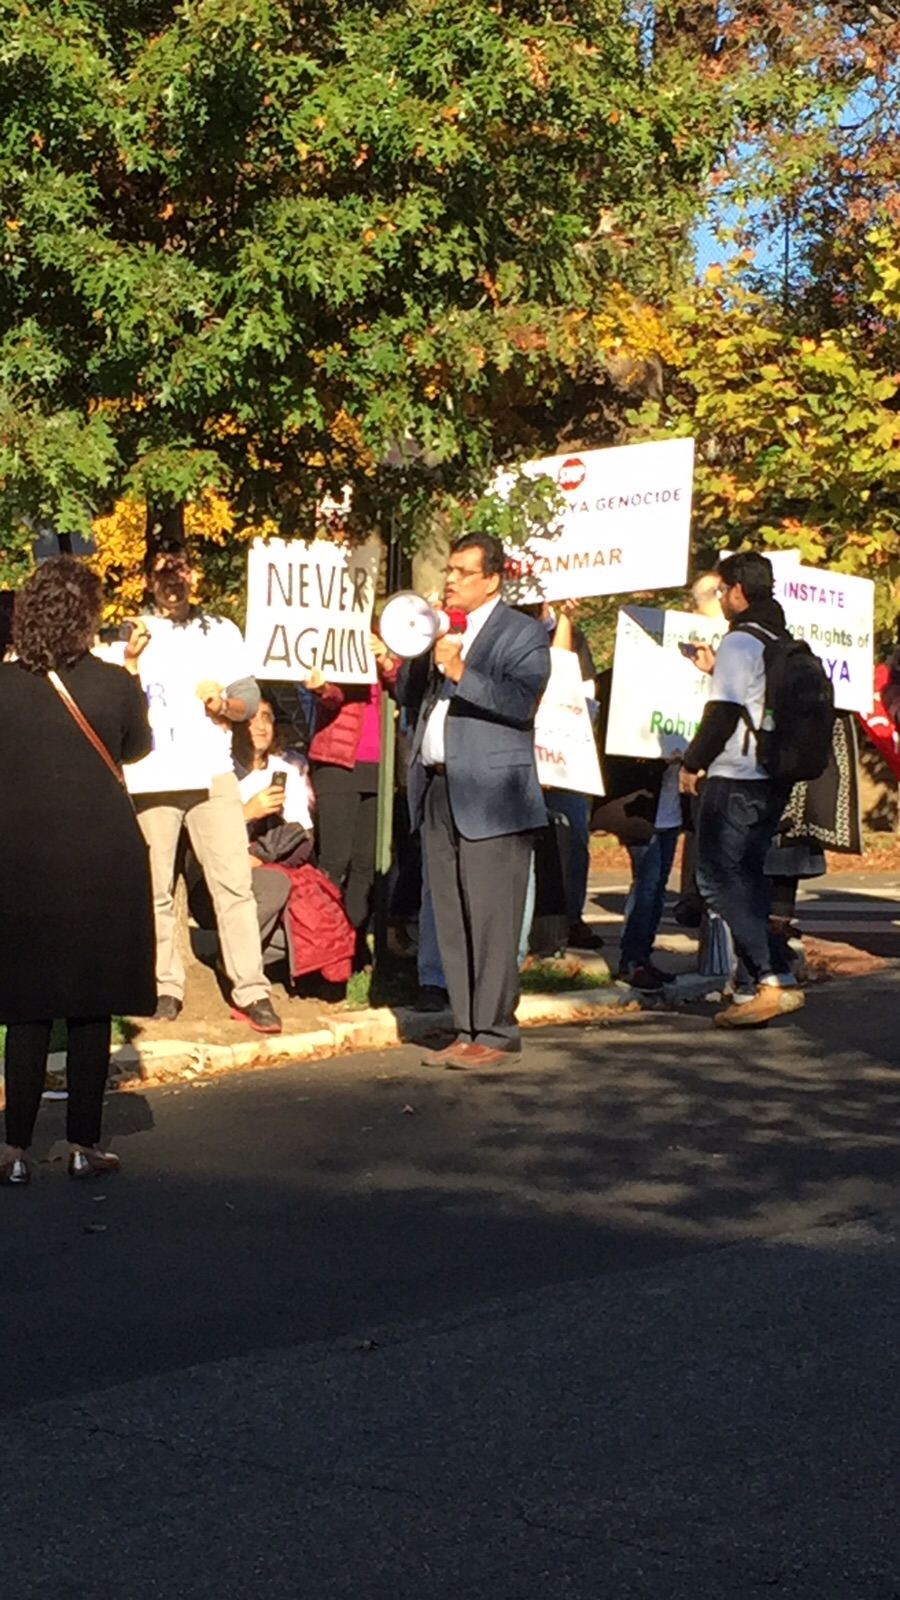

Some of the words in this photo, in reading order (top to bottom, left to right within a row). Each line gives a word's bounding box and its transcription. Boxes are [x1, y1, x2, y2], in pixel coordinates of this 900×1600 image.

[595, 488, 682, 511] GENOCIDE
[267, 562, 370, 612] NEVER
[263, 624, 369, 674] AGAIN
[810, 623, 853, 648] Rights
[857, 633, 870, 648] of
